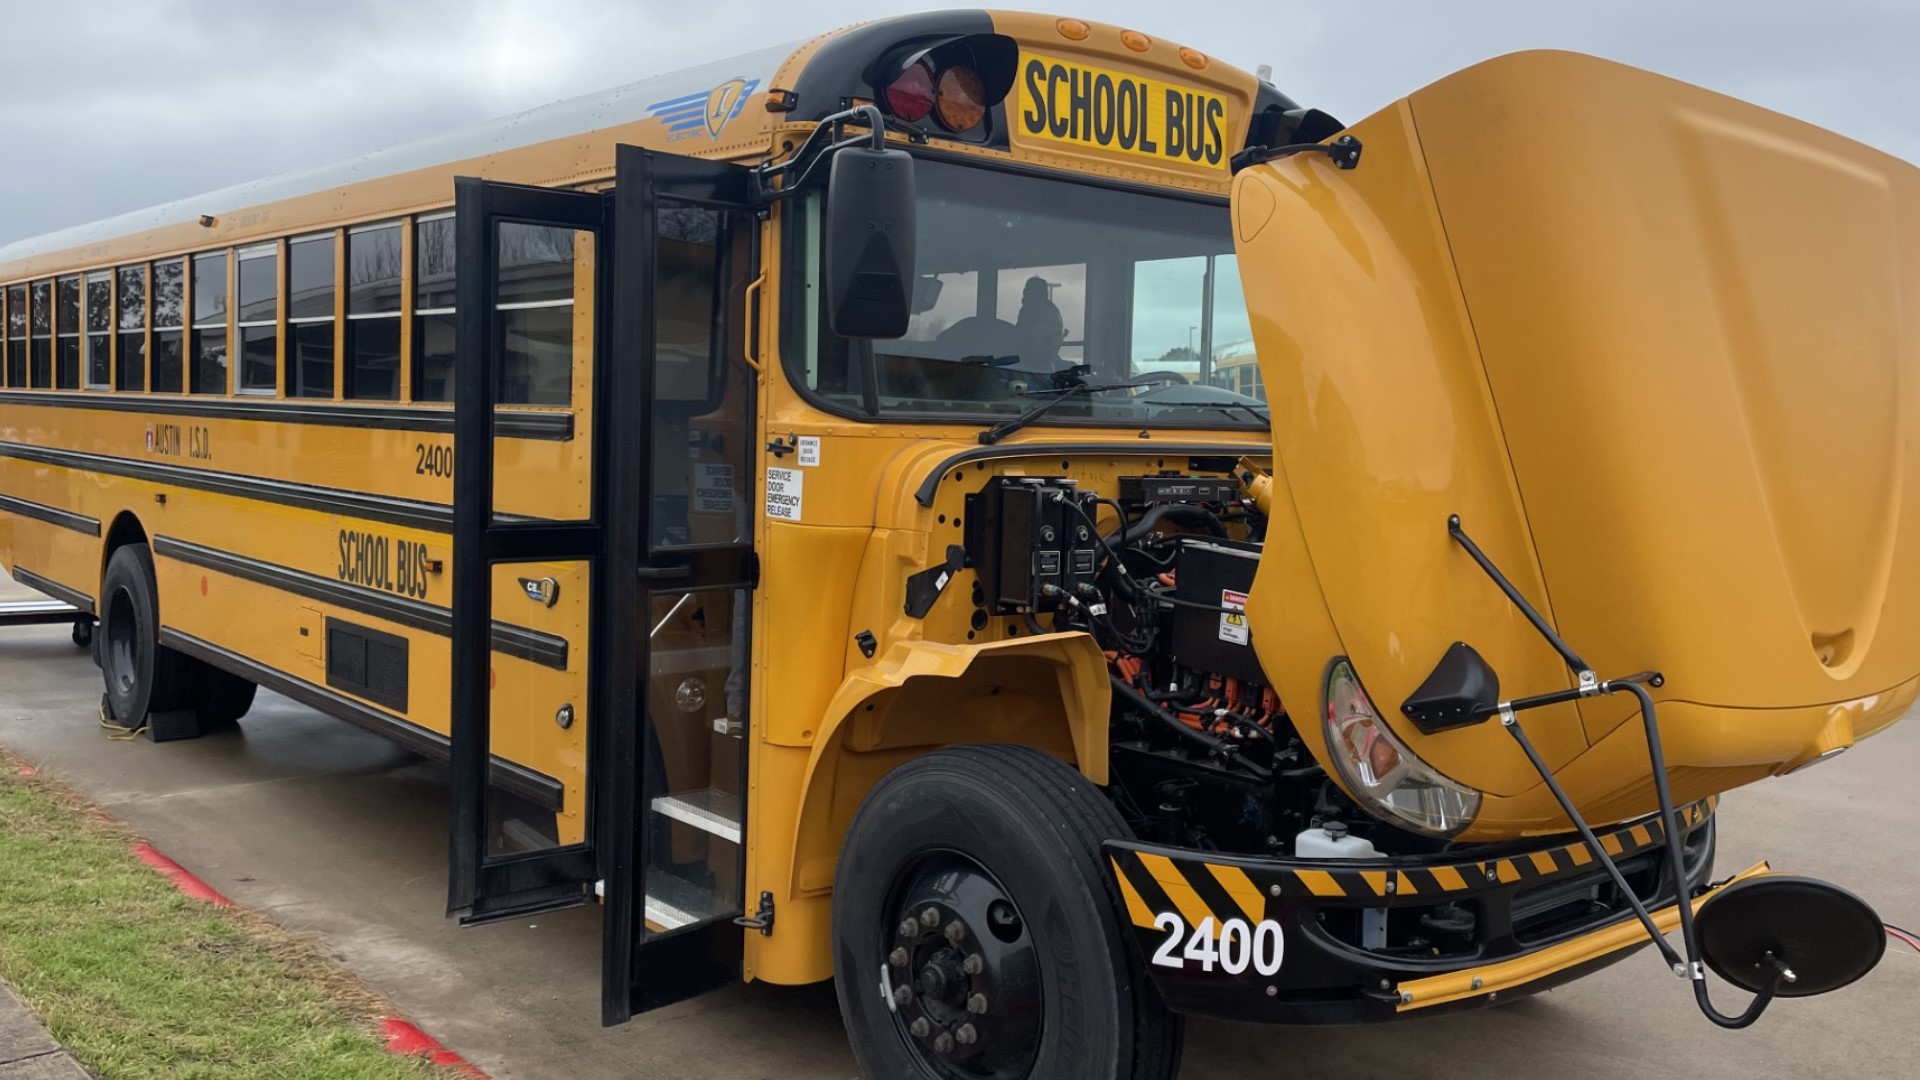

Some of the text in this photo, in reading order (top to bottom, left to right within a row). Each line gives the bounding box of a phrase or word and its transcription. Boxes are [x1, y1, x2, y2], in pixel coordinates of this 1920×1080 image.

[1024, 59, 1223, 165] SCHOOL BUS
[155, 423, 212, 460] AUSTIN I.S.D.
[415, 443, 453, 478] 2400
[768, 468, 792, 482] SERVICE
[767, 480, 784, 492] DOOR
[767, 493, 800, 507] EMERGENCY
[766, 504, 792, 517] RELEASE
[338, 529, 427, 599] SCHOOL BUS
[1152, 912, 1284, 976] 2400
